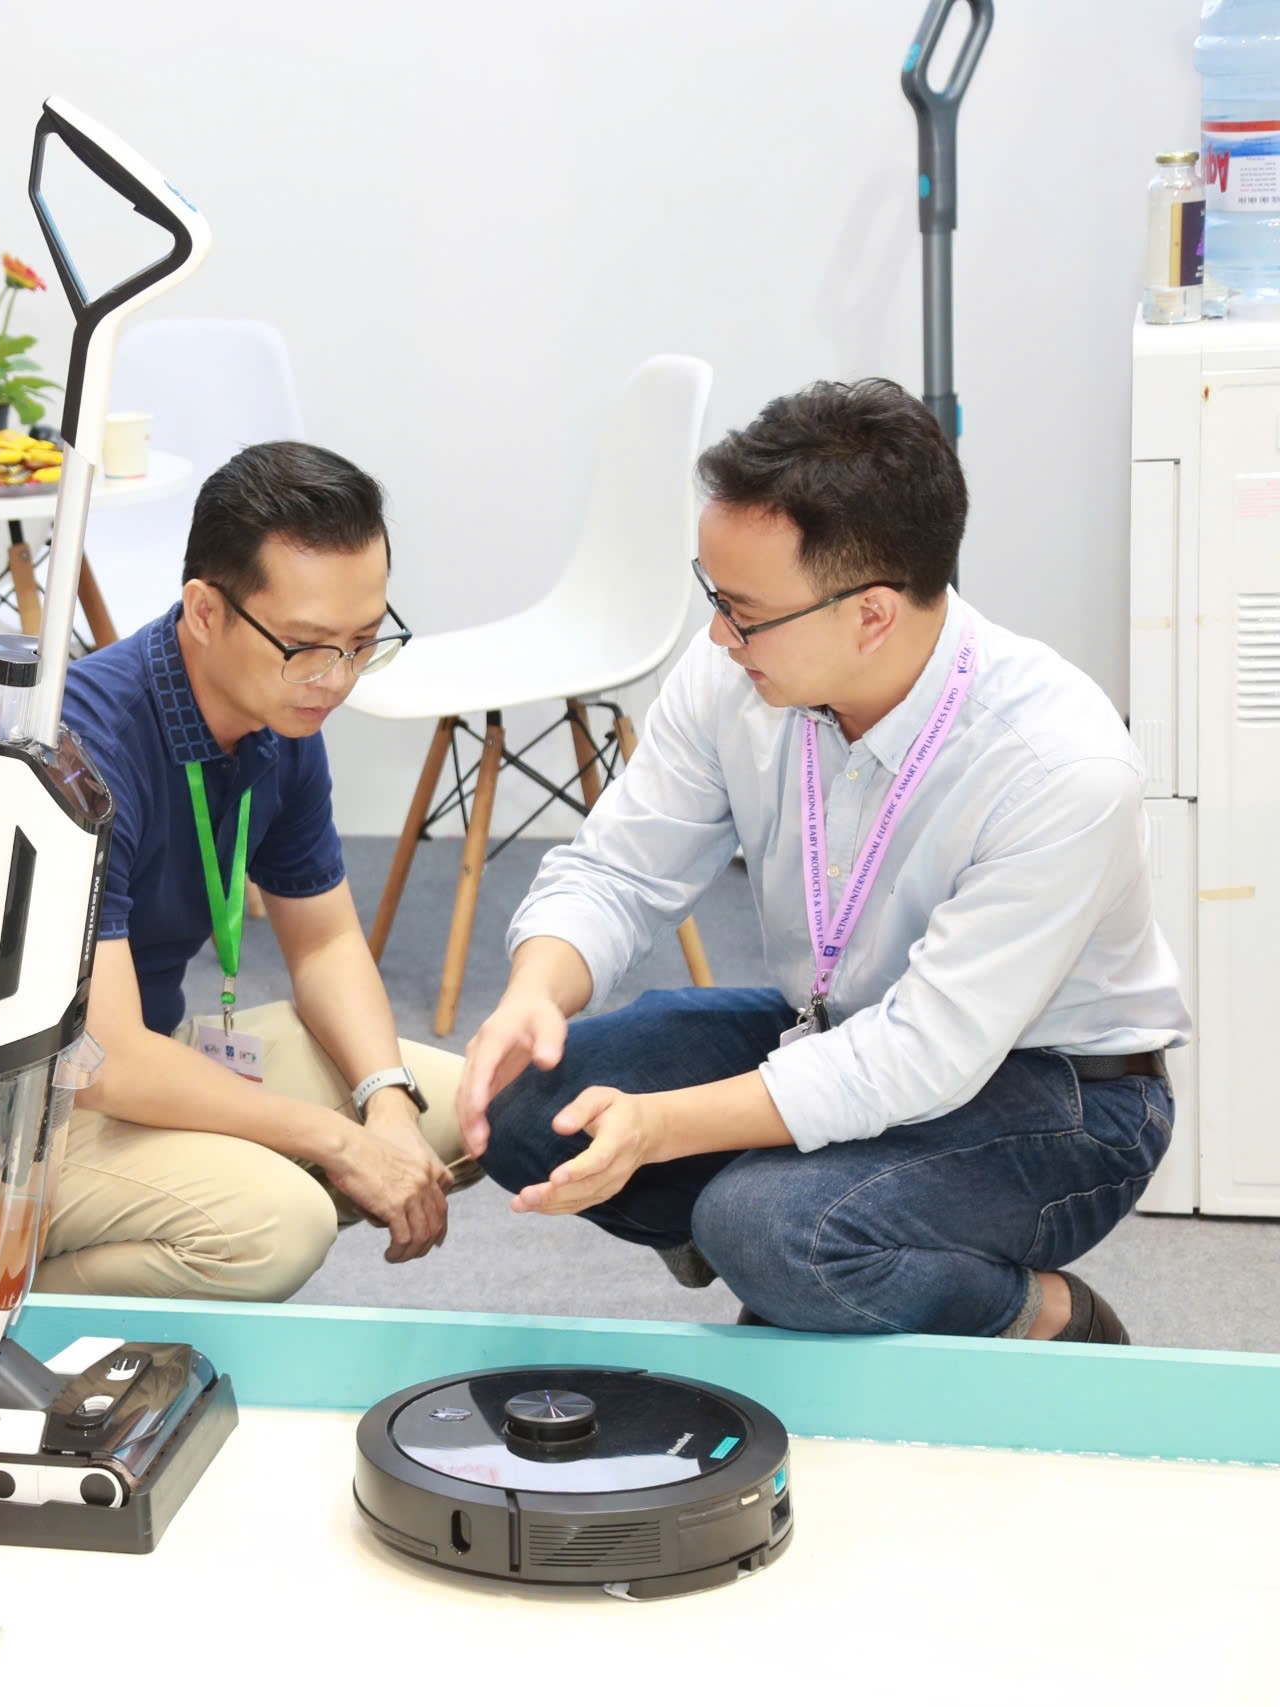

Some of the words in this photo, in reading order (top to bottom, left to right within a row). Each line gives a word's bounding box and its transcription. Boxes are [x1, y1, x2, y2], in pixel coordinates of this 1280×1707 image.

[806, 748, 817, 821] INTERNATIONAL
[833, 903, 854, 940] VIETNAM
[849, 841, 880, 905] INTERNATIONAL
[876, 799, 897, 840] ELECTRIC
[898, 763, 919, 791] SMART
[915, 712, 948, 762] APPLIANCES
[943, 687, 959, 711] EXPO
[808, 824, 818, 847] BABY
[809, 850, 821, 898] PRODUCTS
[84, 876, 101, 961] Mamibot
[814, 909, 823, 932] TOYS
